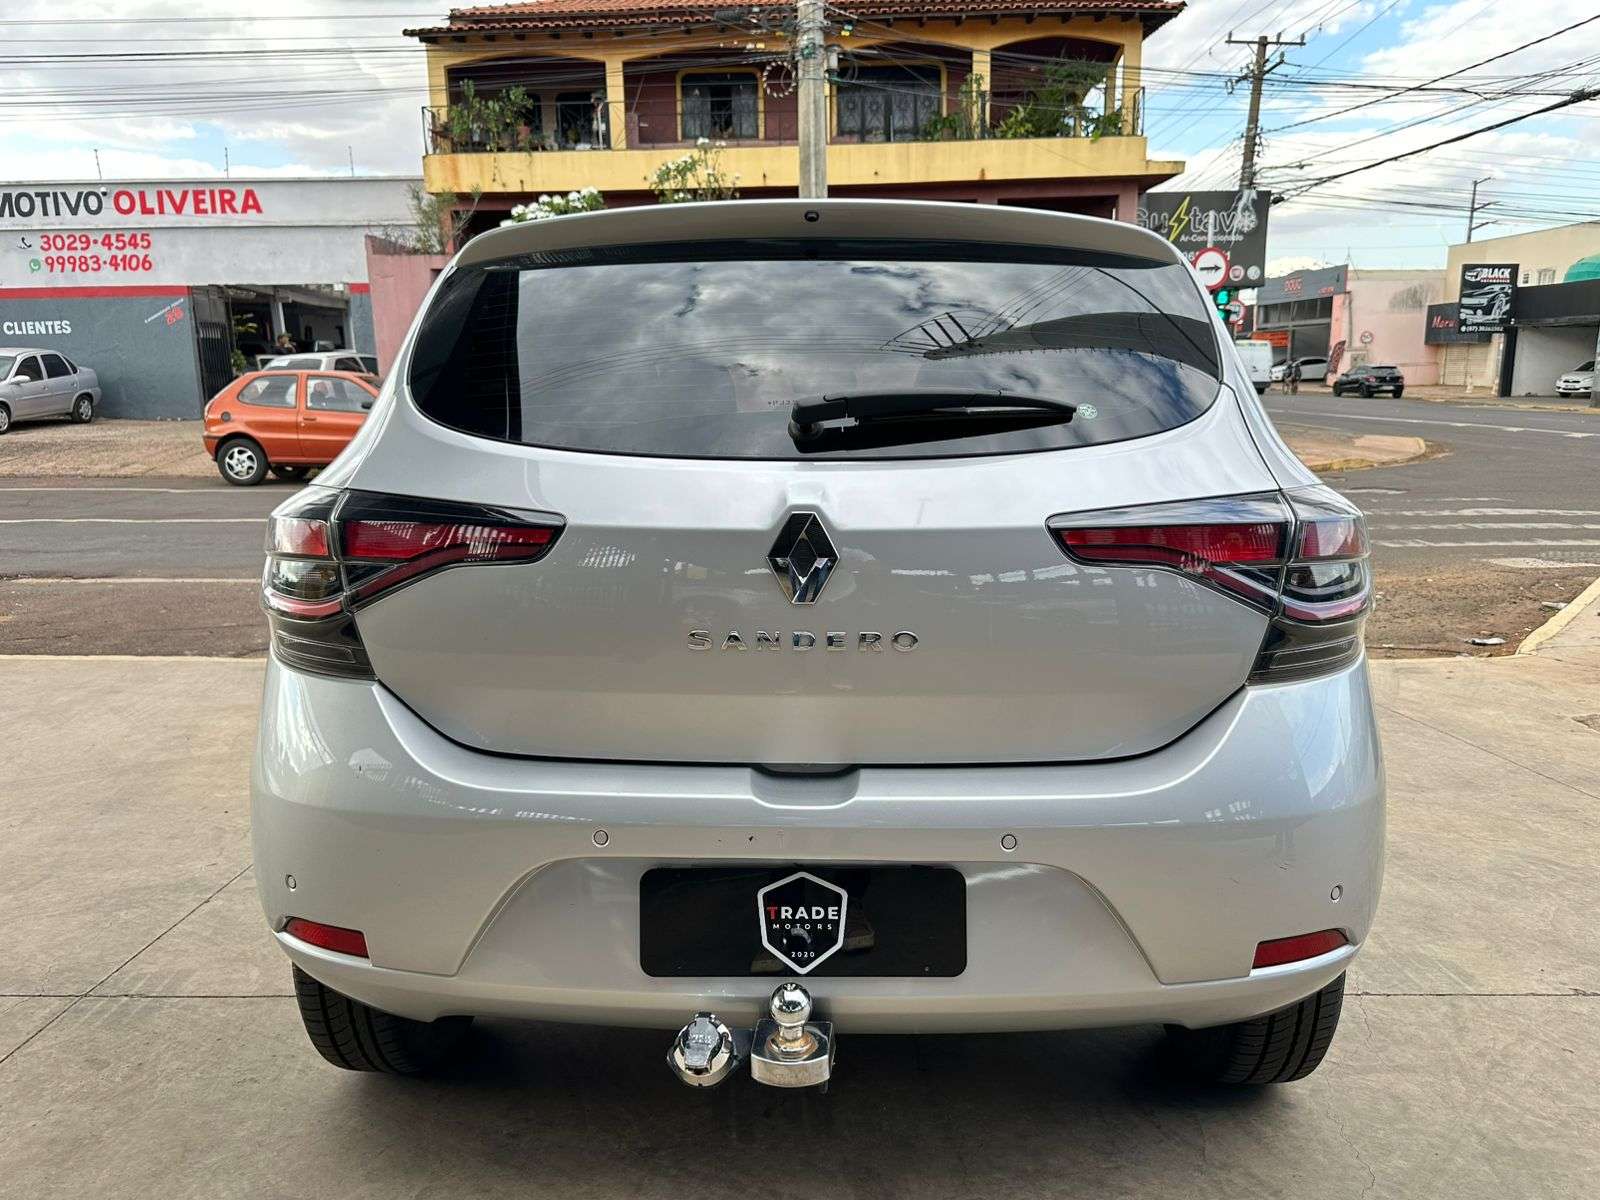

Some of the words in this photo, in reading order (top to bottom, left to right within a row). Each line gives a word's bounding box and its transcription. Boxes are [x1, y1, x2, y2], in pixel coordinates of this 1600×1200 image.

[113, 188, 263, 216] OLIVEIRA
[1481, 268, 1511, 278] BLACK
[3, 319, 72, 335] CLIENTES
[687, 629, 920, 651] SANDERO
[767, 906, 839, 920] TRADE
